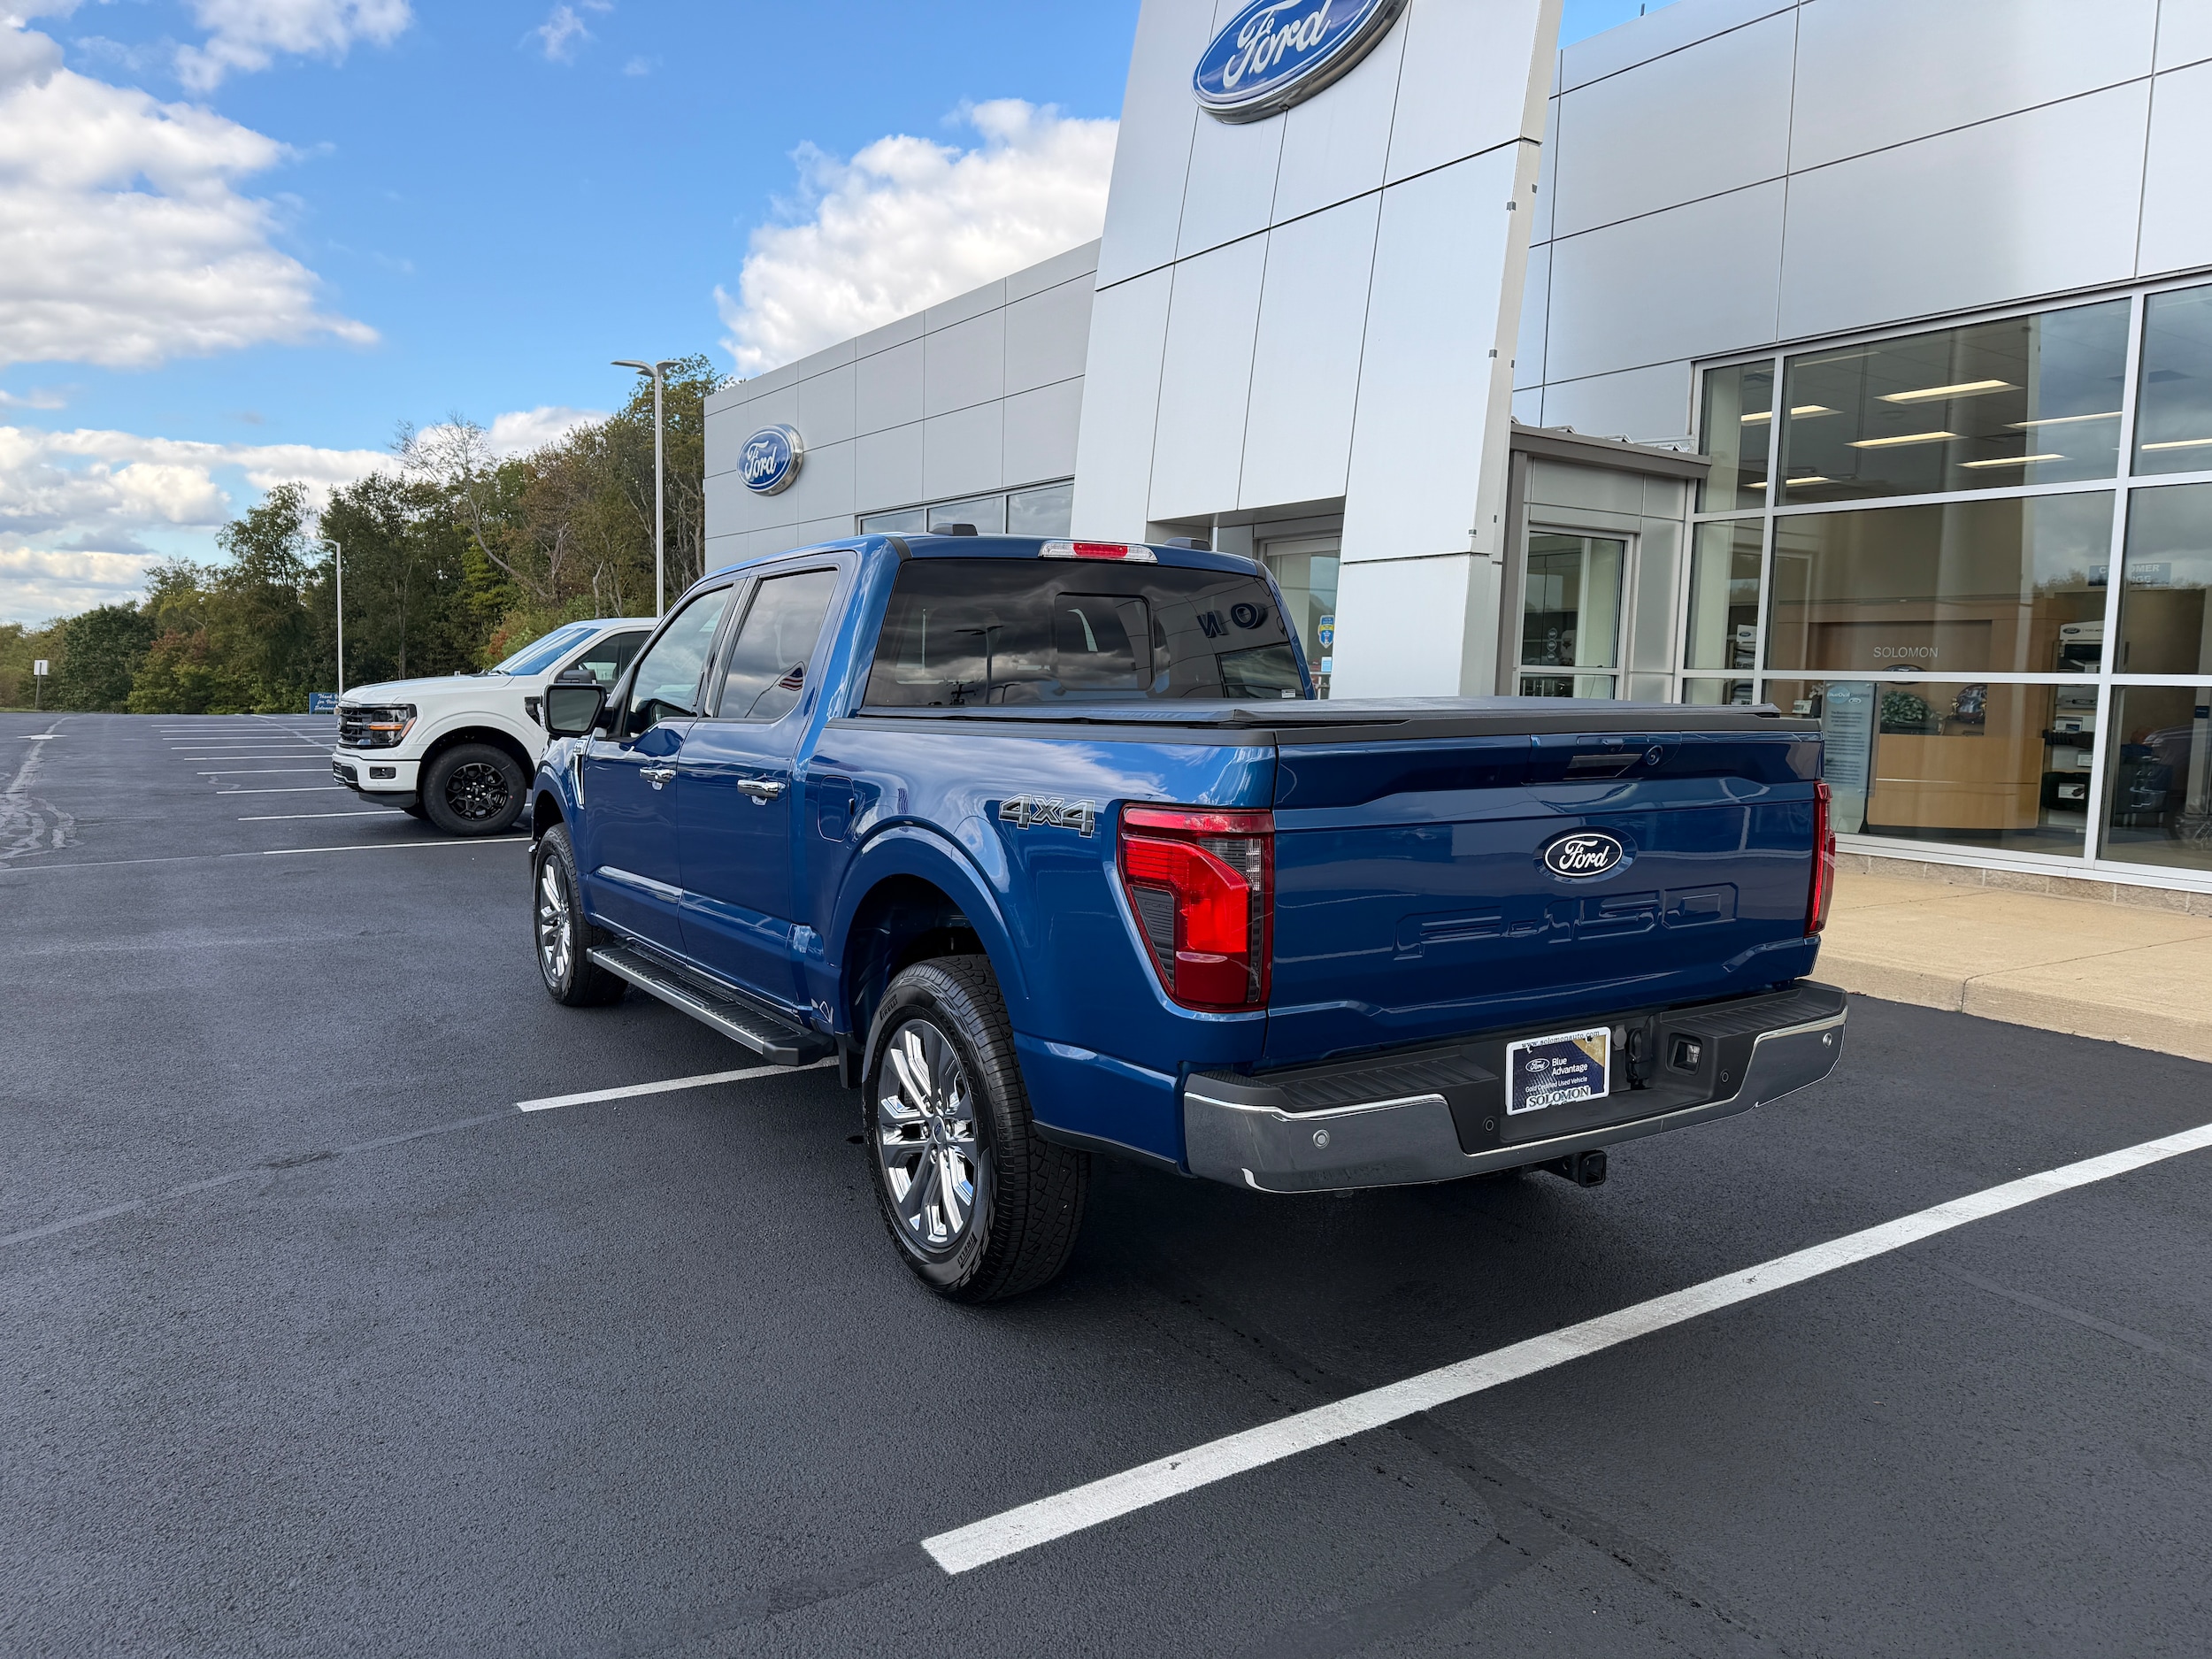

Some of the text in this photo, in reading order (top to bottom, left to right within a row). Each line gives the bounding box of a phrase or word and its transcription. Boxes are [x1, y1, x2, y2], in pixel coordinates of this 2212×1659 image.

[1223, 0, 1331, 88] Ford
[745, 441, 777, 480] Ford
[1873, 647, 1939, 658] SOLOMON
[1559, 840, 1609, 870] Ford
[1394, 882, 1738, 960] F-150
[879, 994, 898, 1021] PIRELLI
[1552, 1057, 1567, 1066] Blue
[1552, 1063, 1588, 1076] Advantage
[1529, 1087, 1589, 1107] SOLOMON
